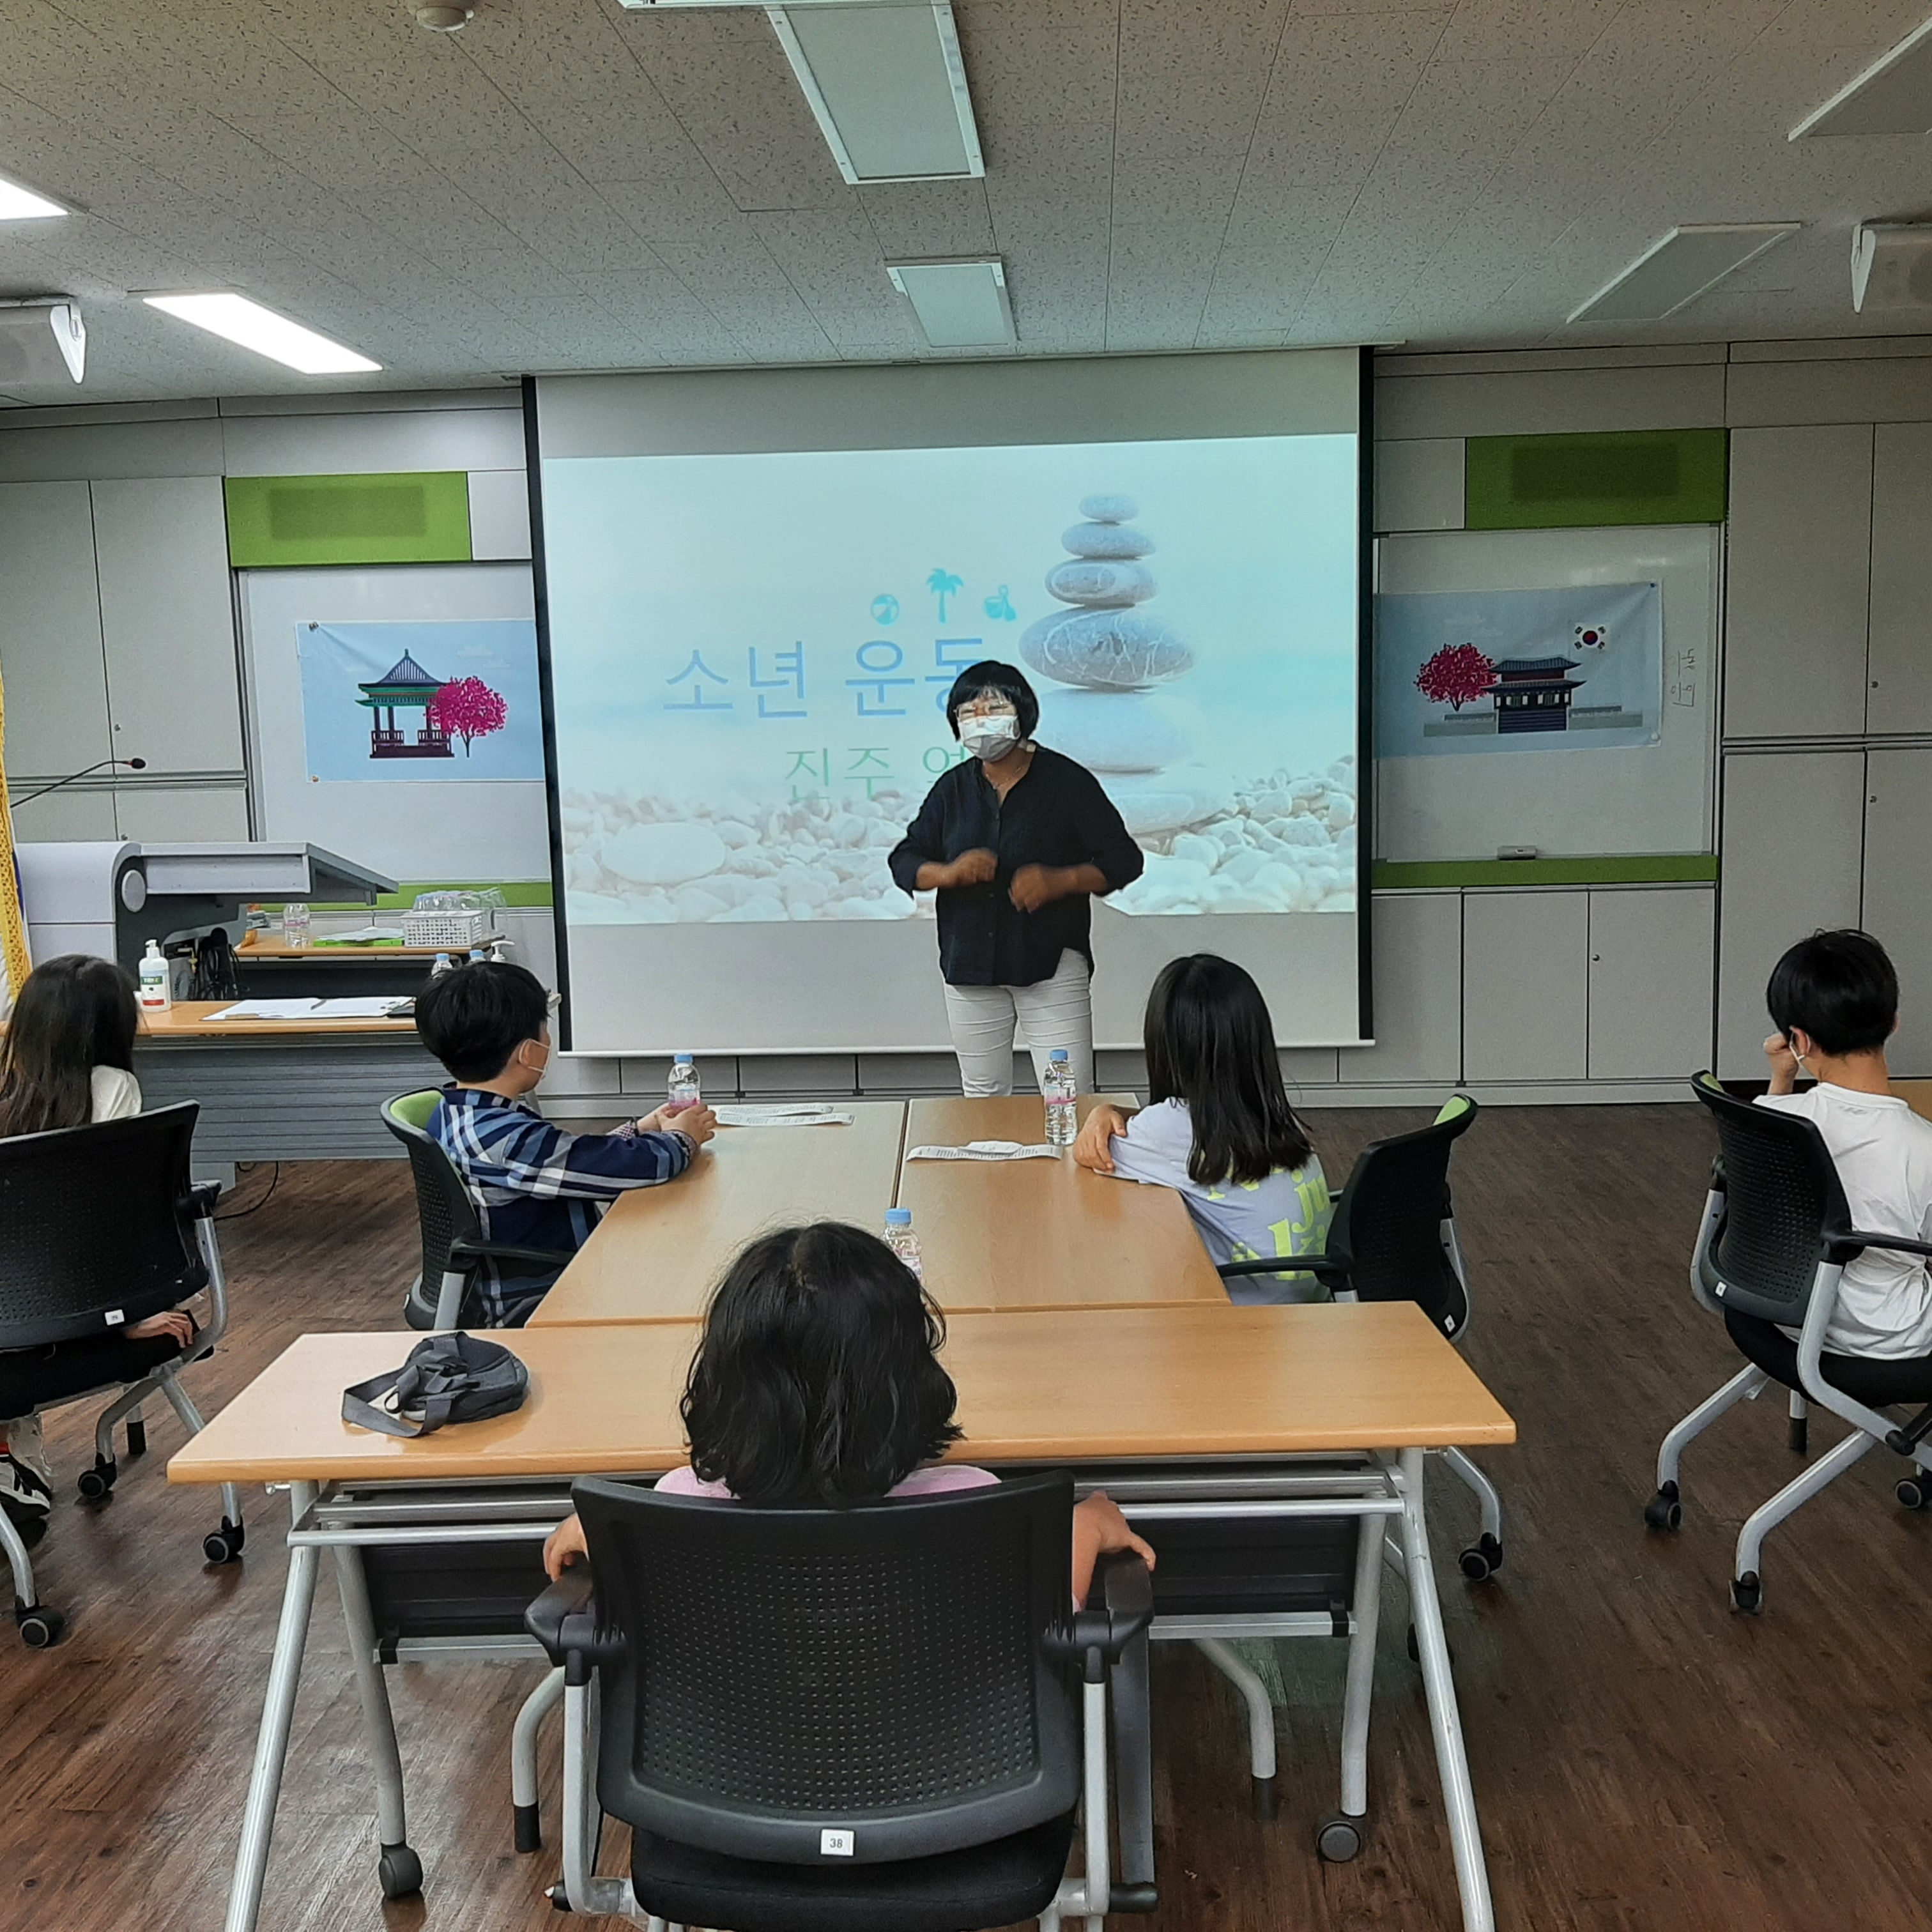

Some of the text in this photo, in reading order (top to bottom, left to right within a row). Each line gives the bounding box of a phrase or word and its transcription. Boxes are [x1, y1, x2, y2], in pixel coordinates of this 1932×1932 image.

[663, 640, 808, 719] 소년
[785, 746, 894, 802] 진주
[829, 1837, 843, 1849] 38
